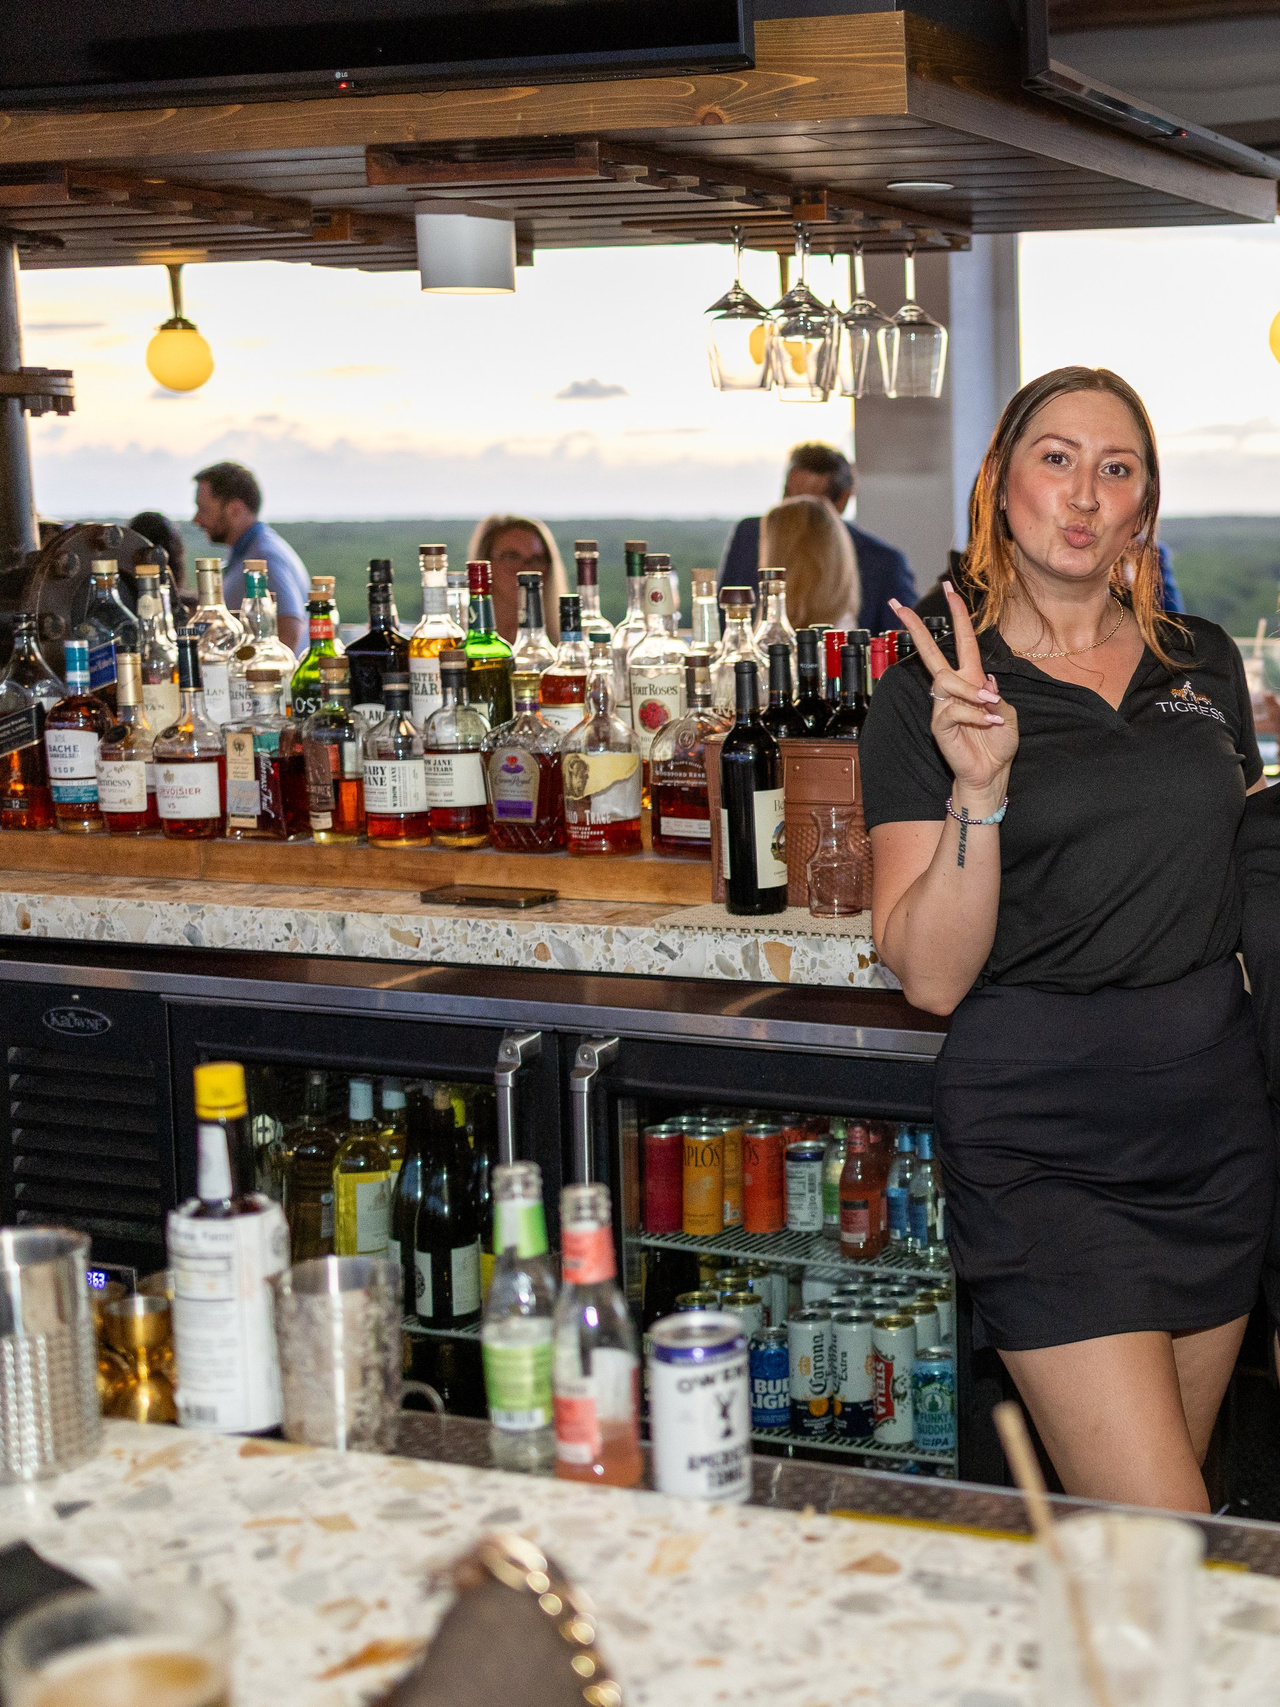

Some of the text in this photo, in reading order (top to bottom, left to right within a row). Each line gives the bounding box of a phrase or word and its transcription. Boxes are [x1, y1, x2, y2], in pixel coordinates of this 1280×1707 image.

[632, 682, 648, 696] Four
[294, 696, 325, 714] OST
[1155, 701, 1226, 724] TIGRESS
[363, 766, 387, 776] BABY
[688, 771, 706, 779] RESE
[99, 780, 132, 788] ennessy
[160, 787, 201, 796] RVOISIER
[12, 800, 21, 809] 12
[583, 809, 612, 826] TRACE
[809, 1331, 828, 1395] Corona
[838, 1351, 848, 1382] Extra
[875, 1361, 887, 1416] STELLA
[750, 1391, 791, 1410] LIGH
[930, 1437, 950, 1447] IPA
